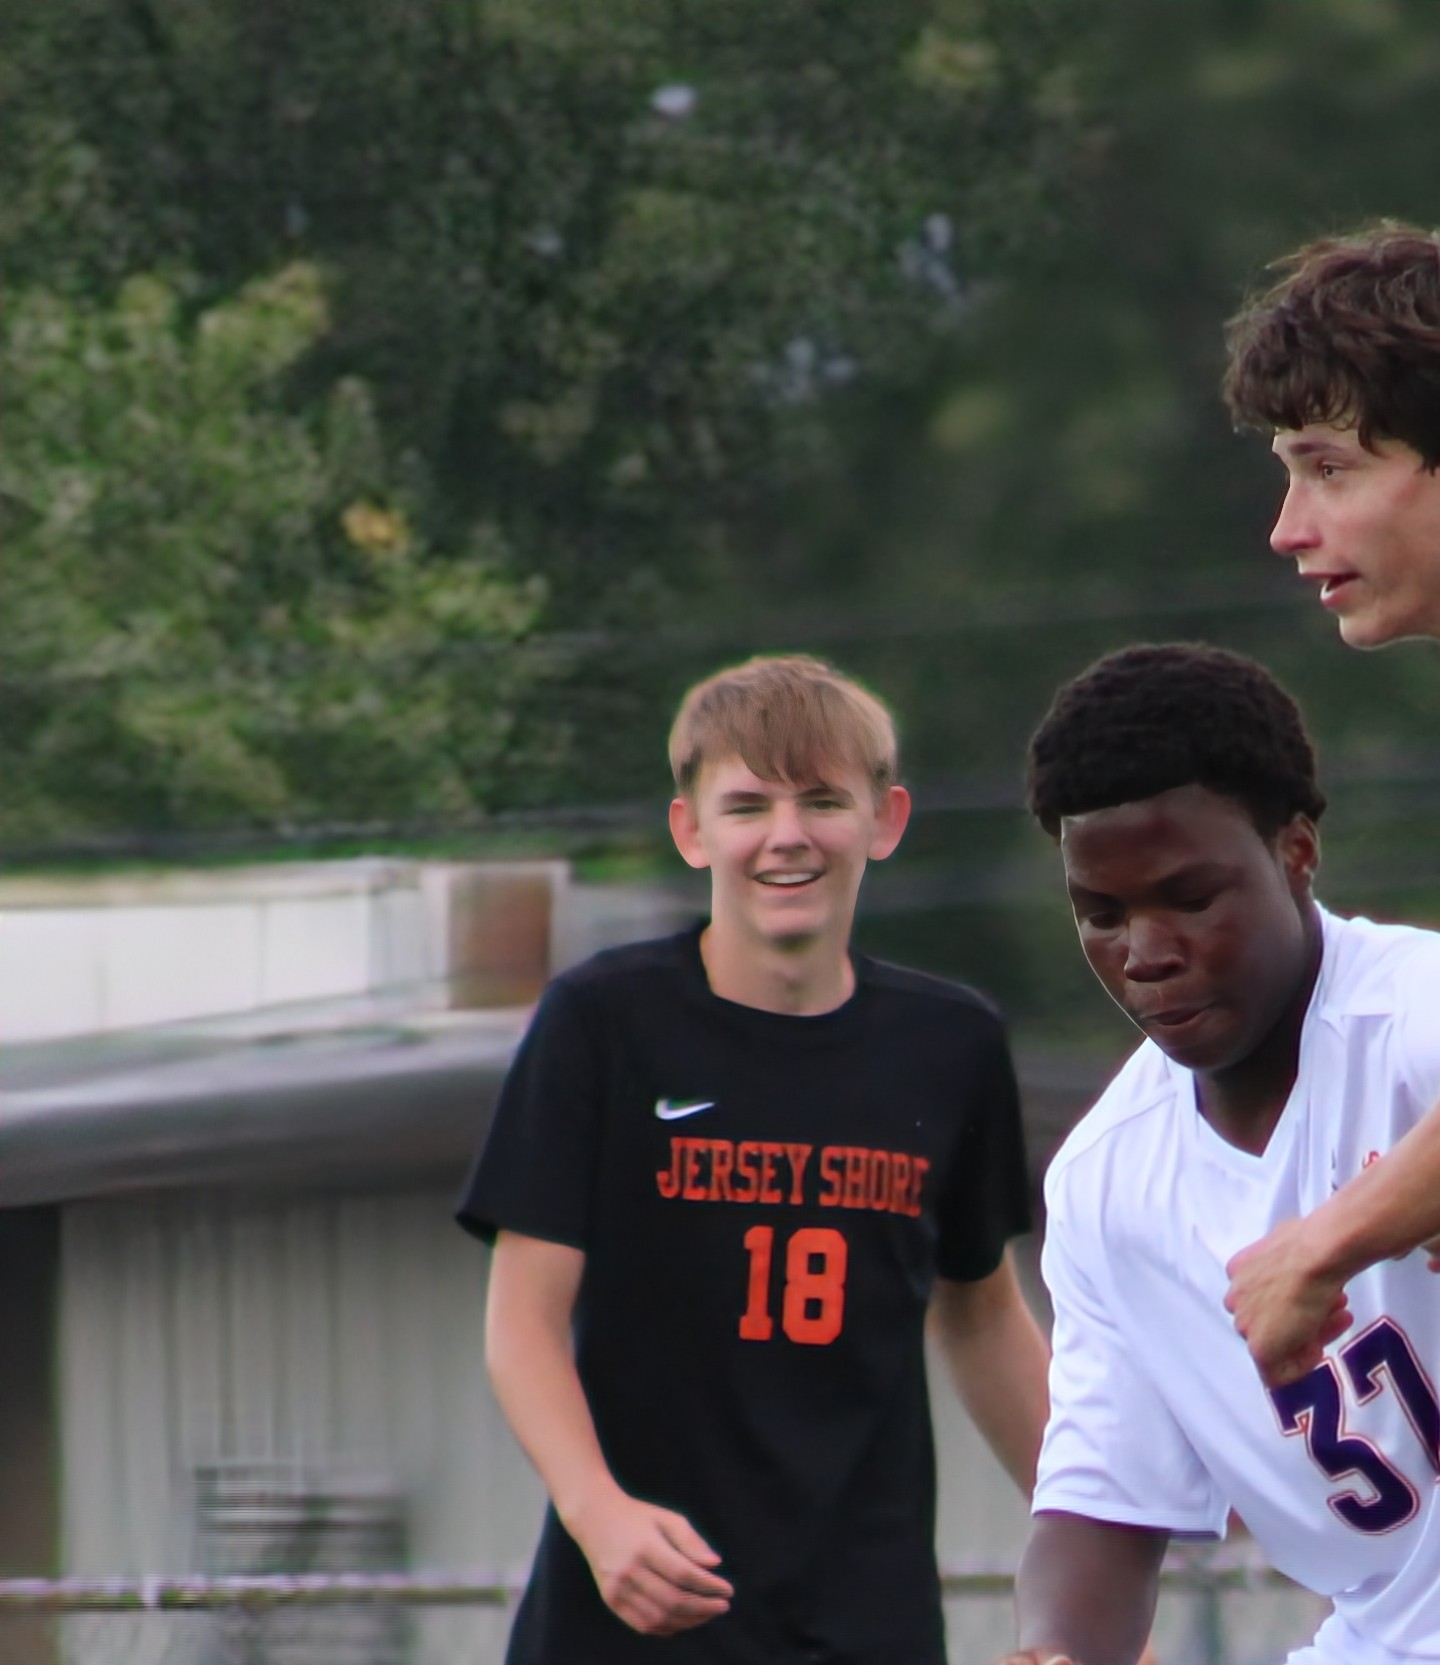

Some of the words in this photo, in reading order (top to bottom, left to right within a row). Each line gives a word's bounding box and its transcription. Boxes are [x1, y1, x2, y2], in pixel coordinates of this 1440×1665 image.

[656, 1136, 812, 1205] JERSEY
[819, 1145, 929, 1218] SHORE
[739, 1225, 847, 1345] 18
